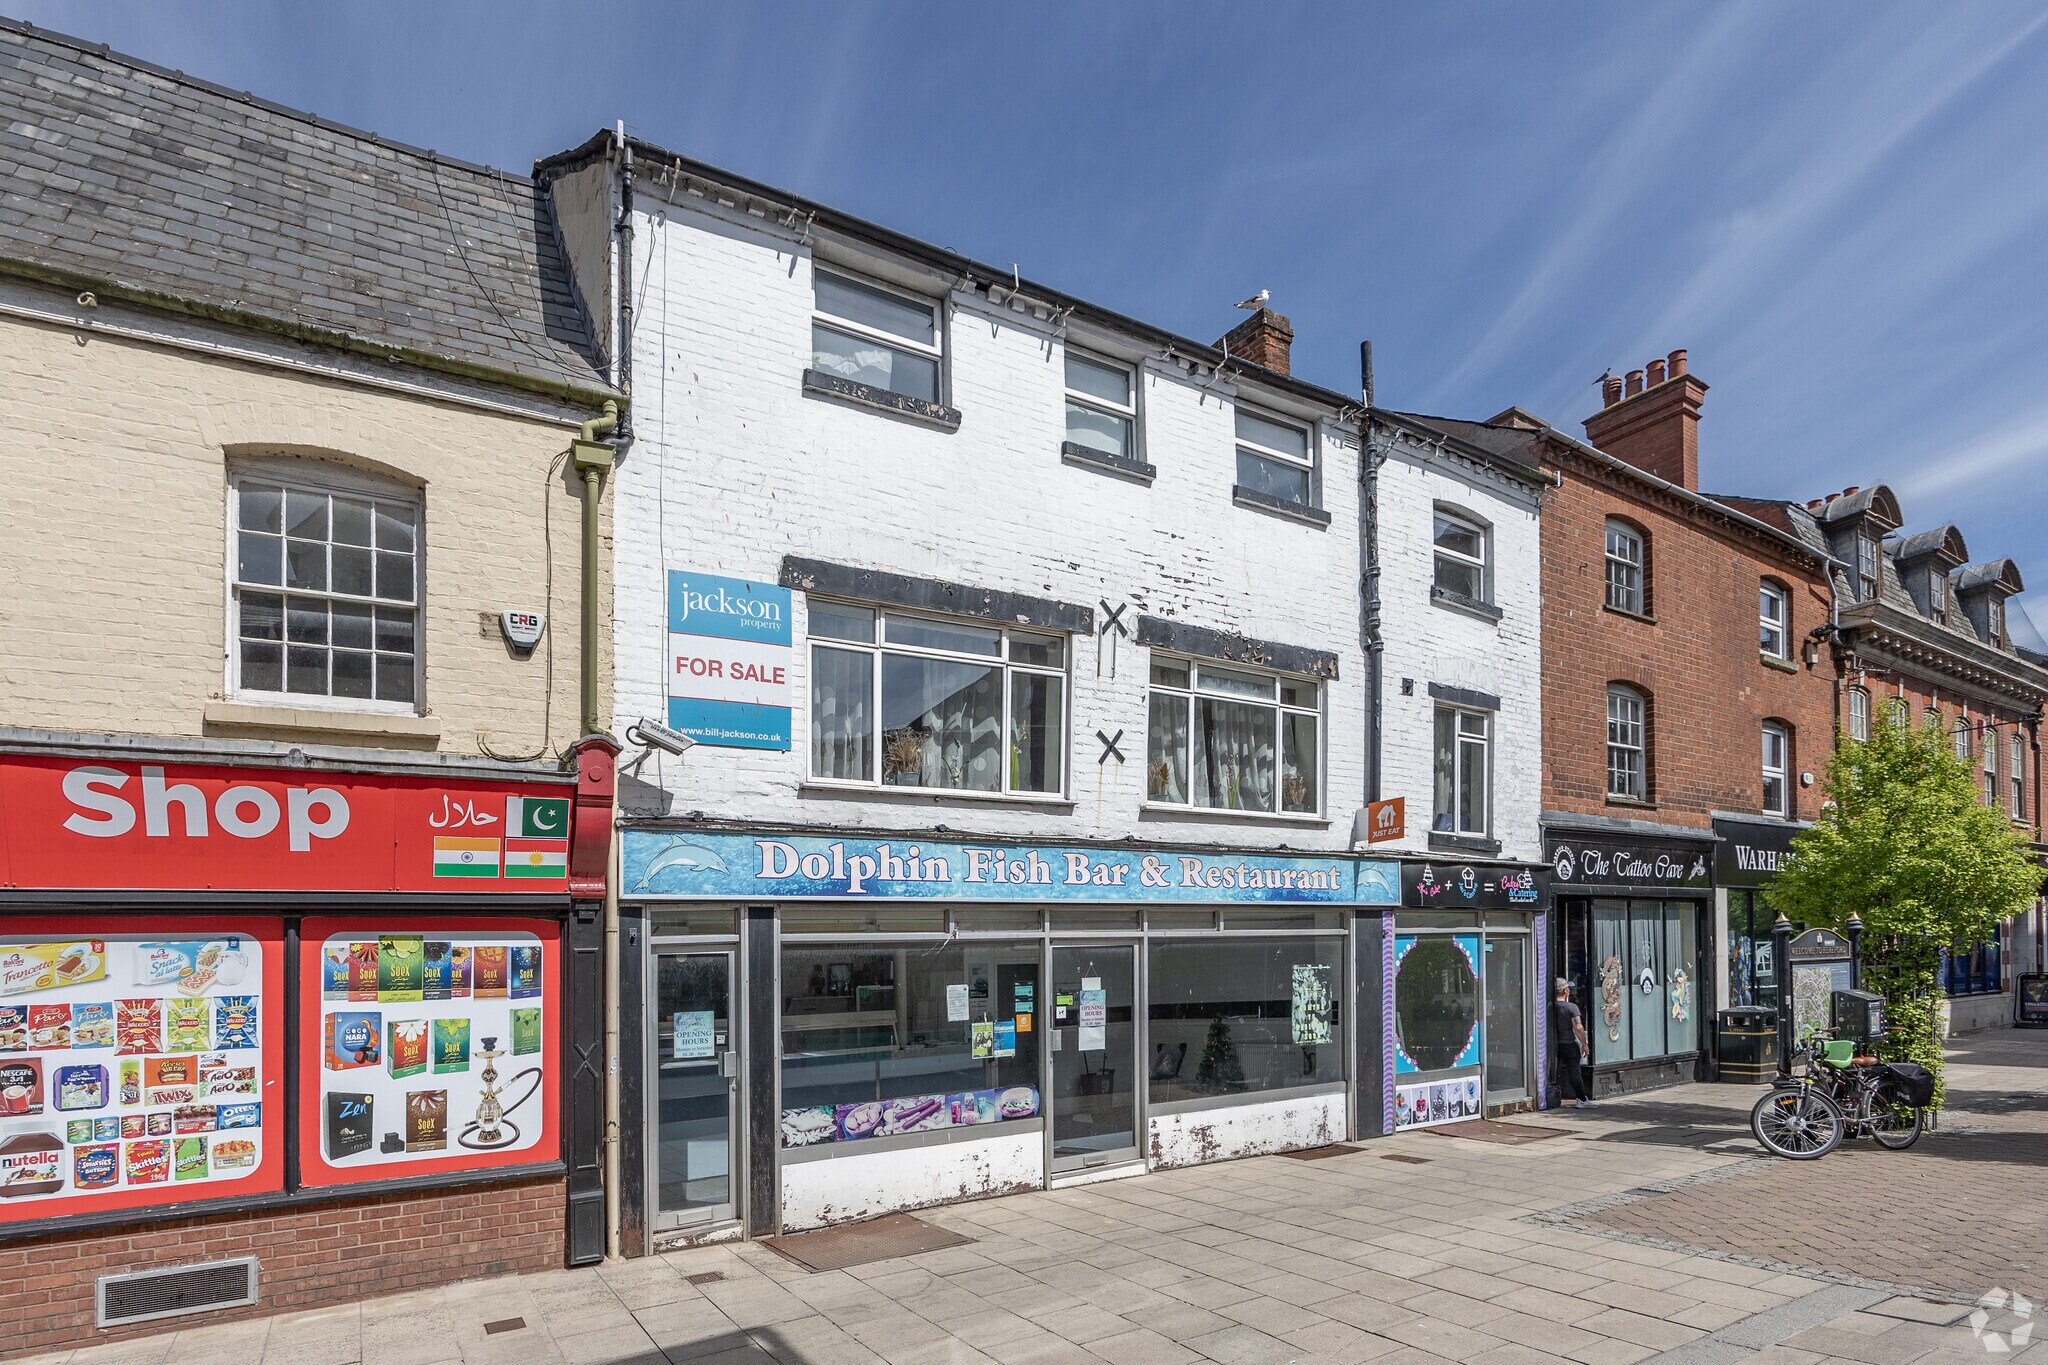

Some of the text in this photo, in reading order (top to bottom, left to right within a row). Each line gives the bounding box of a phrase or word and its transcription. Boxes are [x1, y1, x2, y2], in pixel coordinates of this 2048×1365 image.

[681, 583, 782, 622] jackson
[510, 613, 538, 626] CRG
[740, 618, 782, 632] property
[676, 656, 785, 685] FOR SALE
[680, 727, 781, 742] www.bill-jackson.co.uk
[62, 766, 351, 852] Shop
[429, 793, 499, 828] حلال
[1372, 827, 1400, 839] JUST EAT
[755, 840, 1341, 894] Dolphin Fish Bar & Restaurant
[1581, 849, 1684, 879] The Tattoo Cave
[150, 954, 185, 975] Snack
[165, 964, 182, 975] latte
[3, 960, 54, 985] Trancetto
[34, 1012, 67, 1024] Party
[77, 1011, 109, 1022] Party
[178, 1019, 200, 1027] WALKERS
[127, 1021, 150, 1029] WALKERS
[676, 1030, 712, 1039] OPENING
[682, 1037, 709, 1046] HOURS
[153, 1090, 190, 1104] TWIX
[223, 1104, 256, 1117] OREO
[339, 1100, 367, 1119] Zen
[2, 1152, 59, 1168] nutella
[128, 1156, 168, 1172] Skittles
[176, 1154, 206, 1167] Skittles
[150, 1173, 166, 1181] 196g
